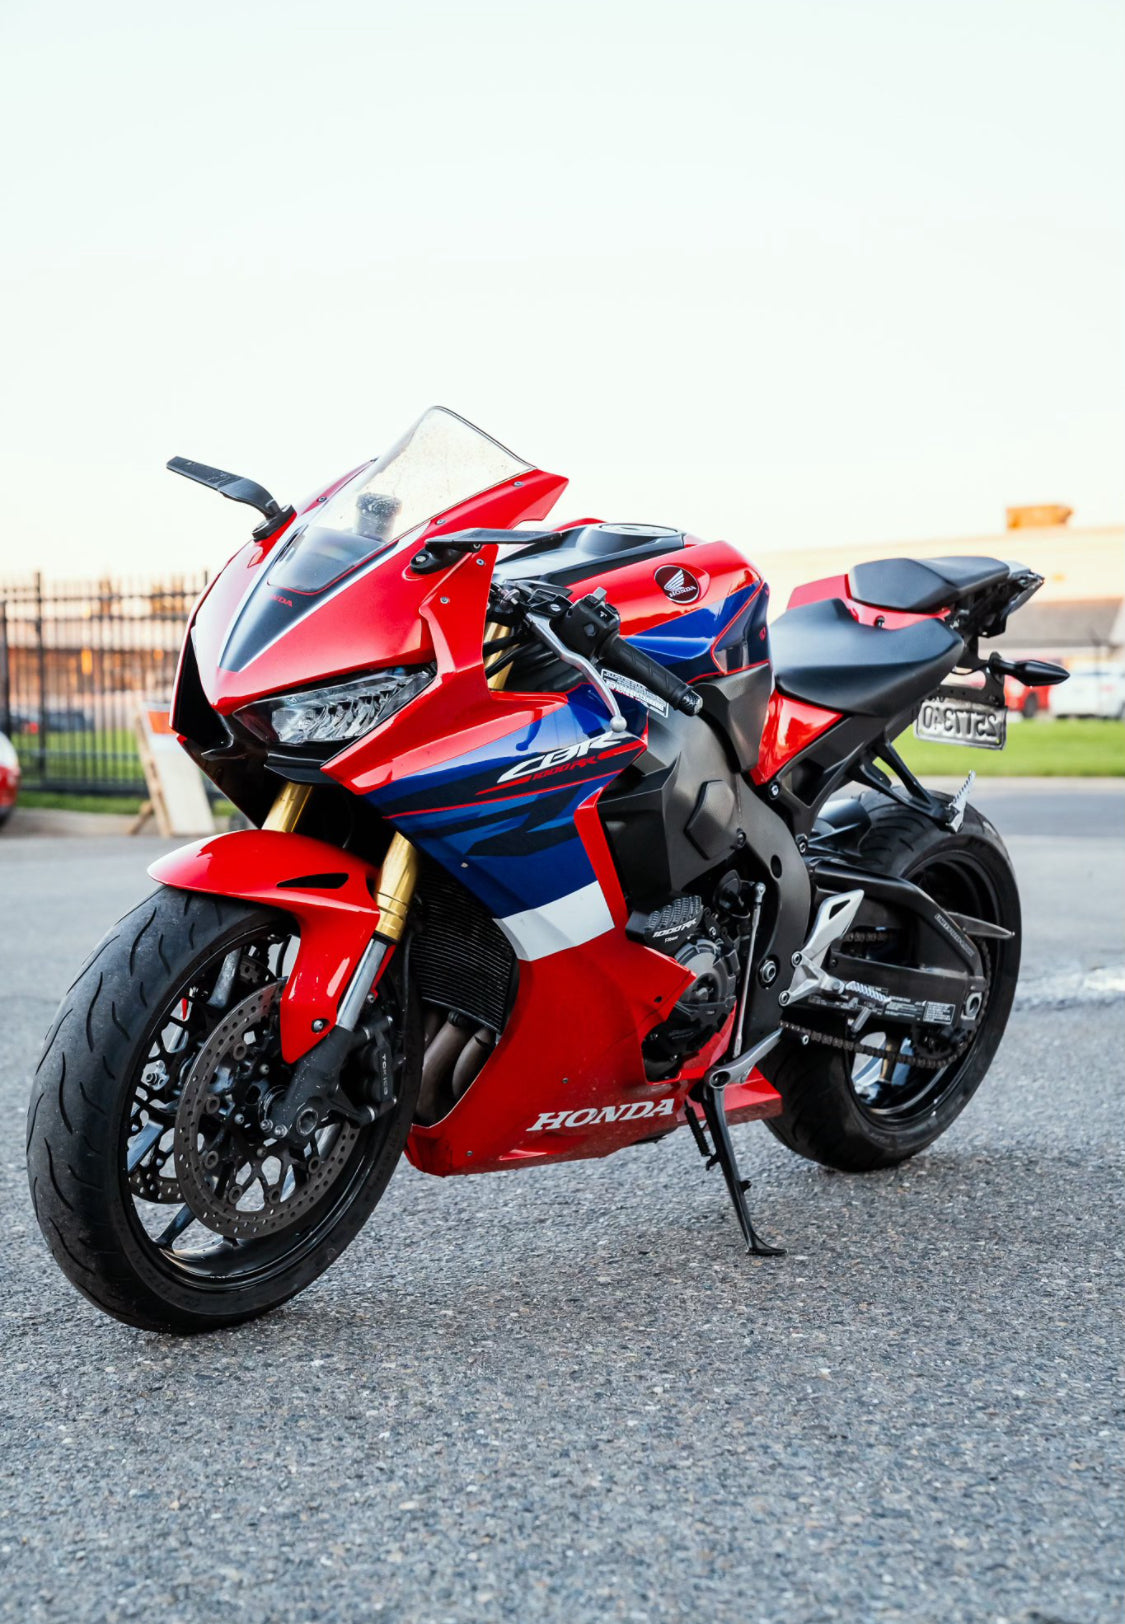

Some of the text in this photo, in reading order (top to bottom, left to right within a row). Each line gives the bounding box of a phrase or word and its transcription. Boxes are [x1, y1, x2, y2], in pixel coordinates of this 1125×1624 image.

[669, 585, 697, 597] HONDA
[497, 731, 622, 784] CBR
[525, 1098, 675, 1132] HONDA
